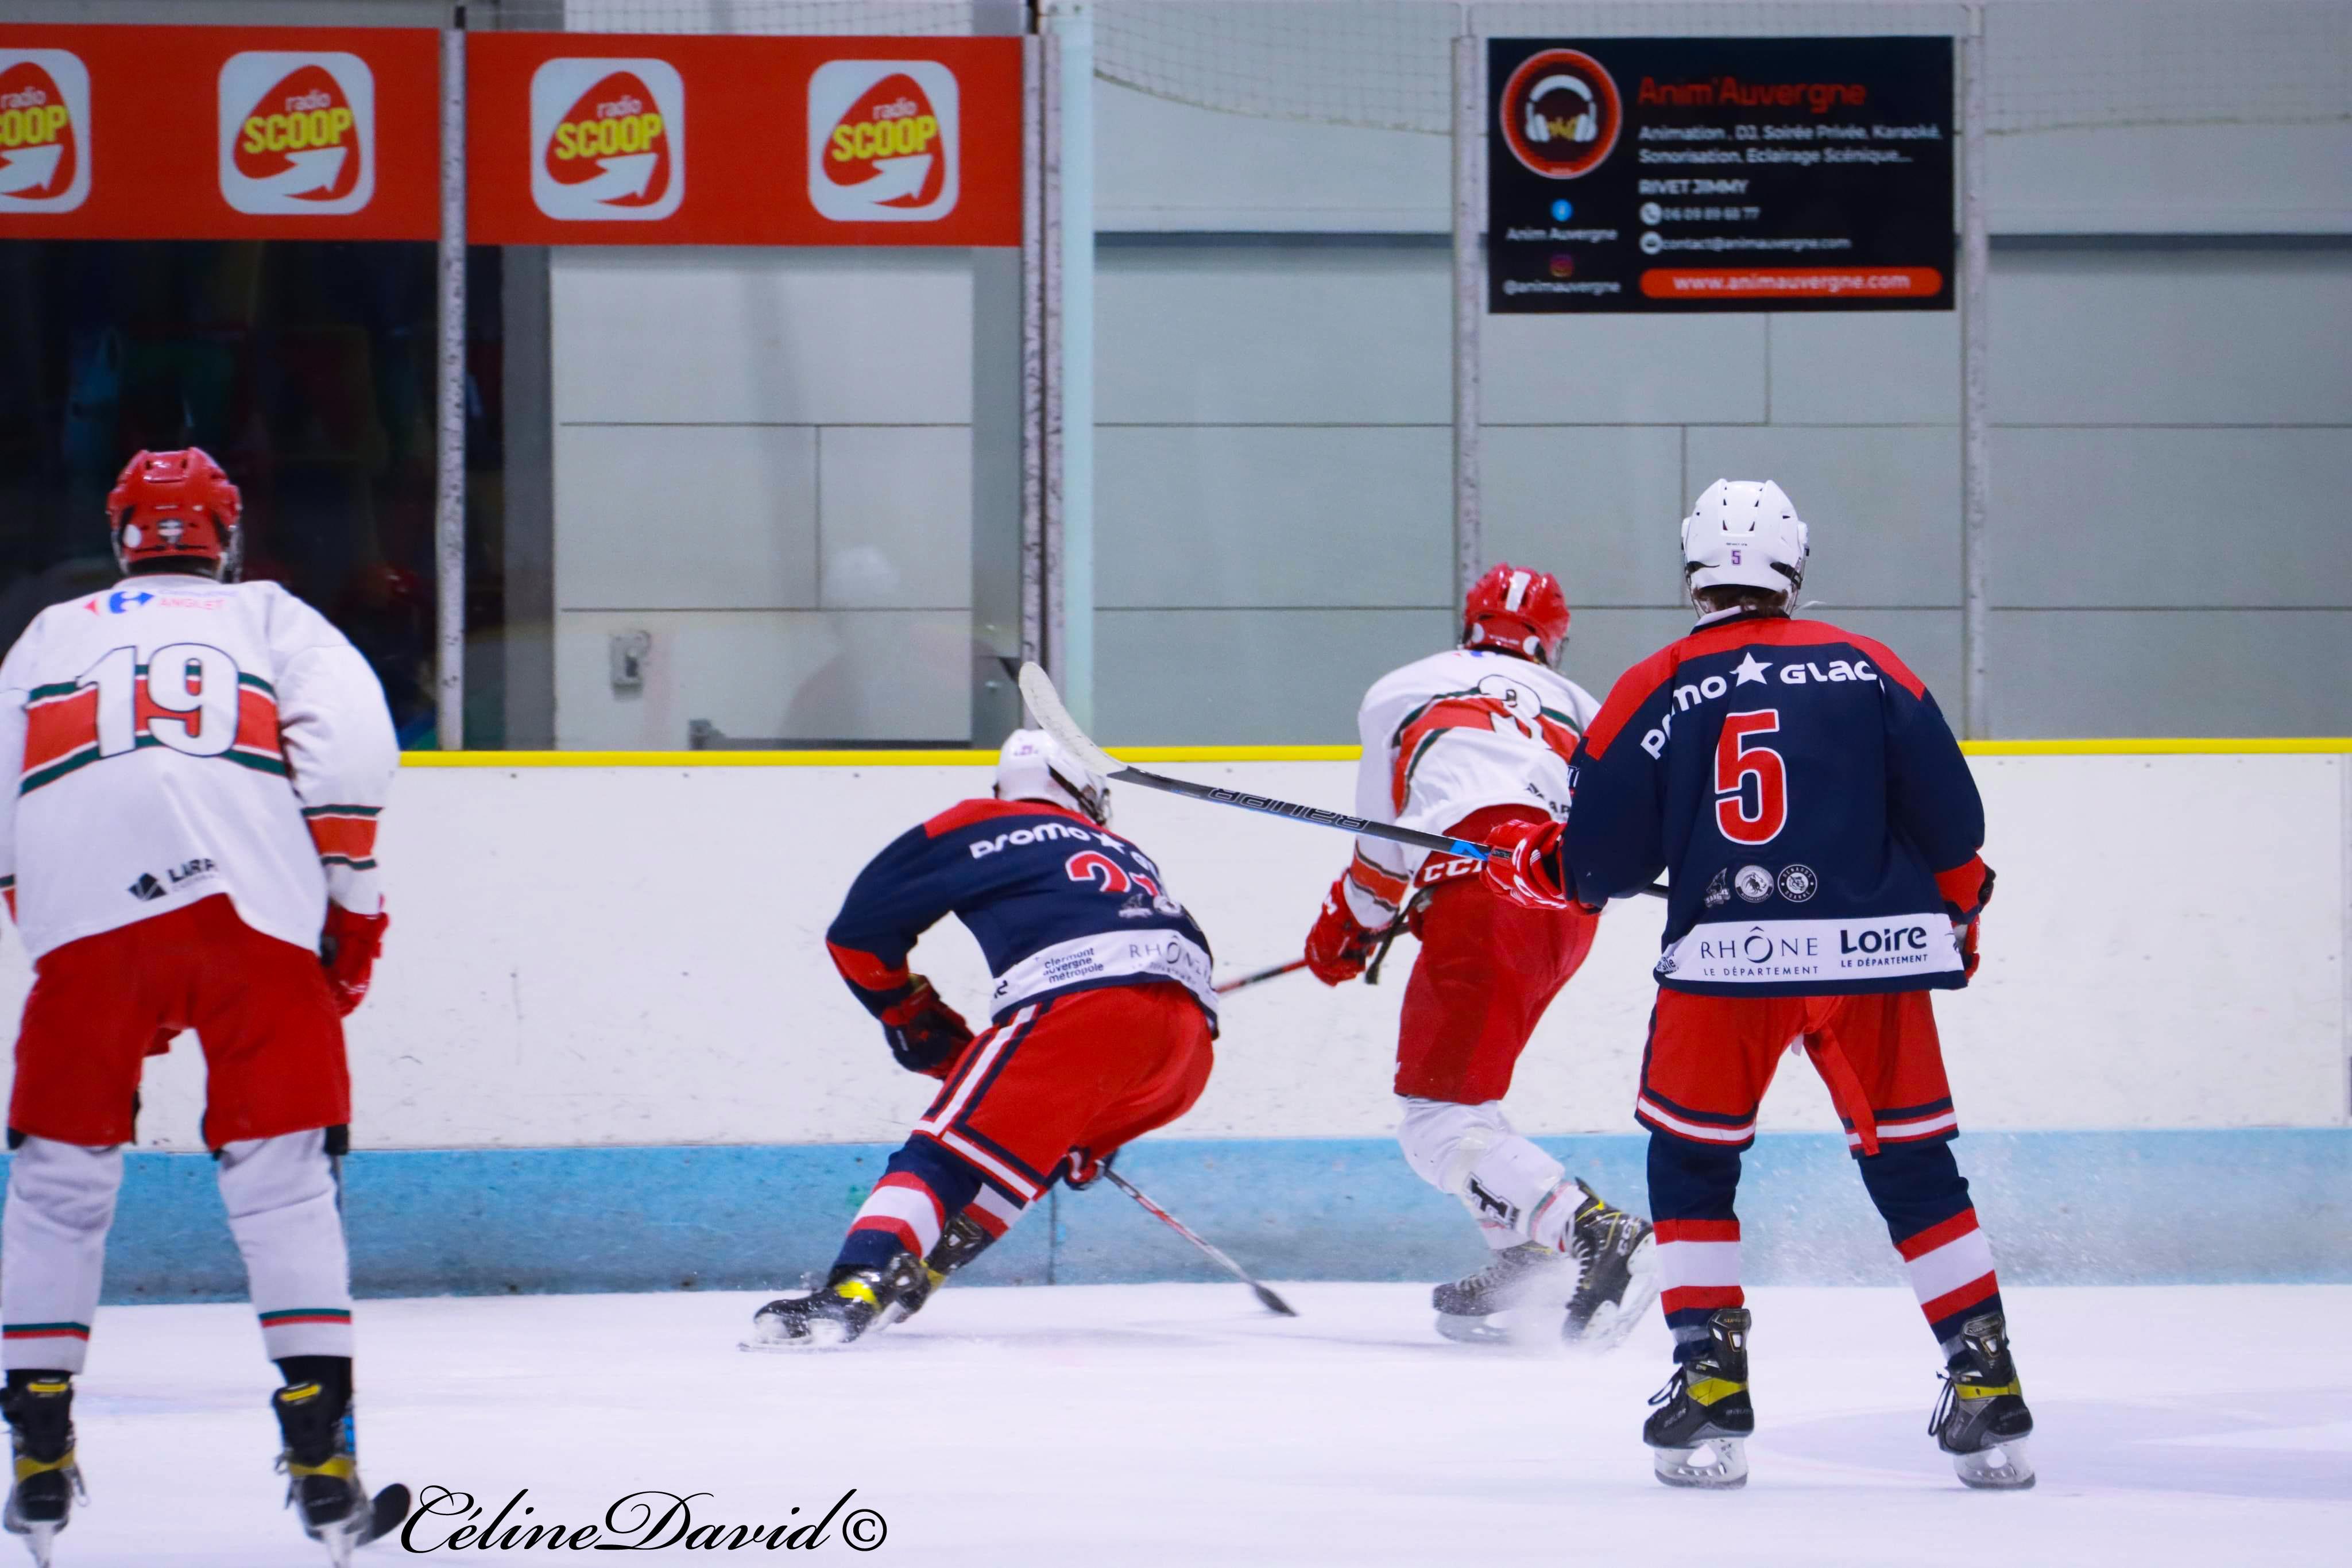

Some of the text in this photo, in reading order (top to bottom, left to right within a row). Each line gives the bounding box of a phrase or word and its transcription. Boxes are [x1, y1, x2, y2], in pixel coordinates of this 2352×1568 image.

[0, 86, 46, 110] radio
[285, 88, 332, 112] radio
[596, 95, 642, 118] radio
[1637, 76, 1866, 113] Anim'Auvergne
[872, 96, 918, 119] radio
[0, 105, 68, 146] OOP
[242, 107, 353, 154] SCOOP
[555, 113, 663, 160] SCOOP
[830, 114, 939, 162] SCOOP
[1549, 226, 1618, 244] Auvergne
[1502, 279, 1621, 296] @animauvergne
[1673, 272, 1911, 293] www.animauvergne.com
[1731, 549, 1741, 566] 5
[75, 642, 240, 758] 19
[1715, 708, 1787, 845] 5
[1700, 926, 1819, 964] RHÔNE
[1840, 926, 1927, 954] Loire
[1044, 947, 1095, 969] clermont
[1841, 954, 1928, 968] LE DÉPARTEMENT
[1704, 966, 1819, 977] LE DÉPARTEMENT
